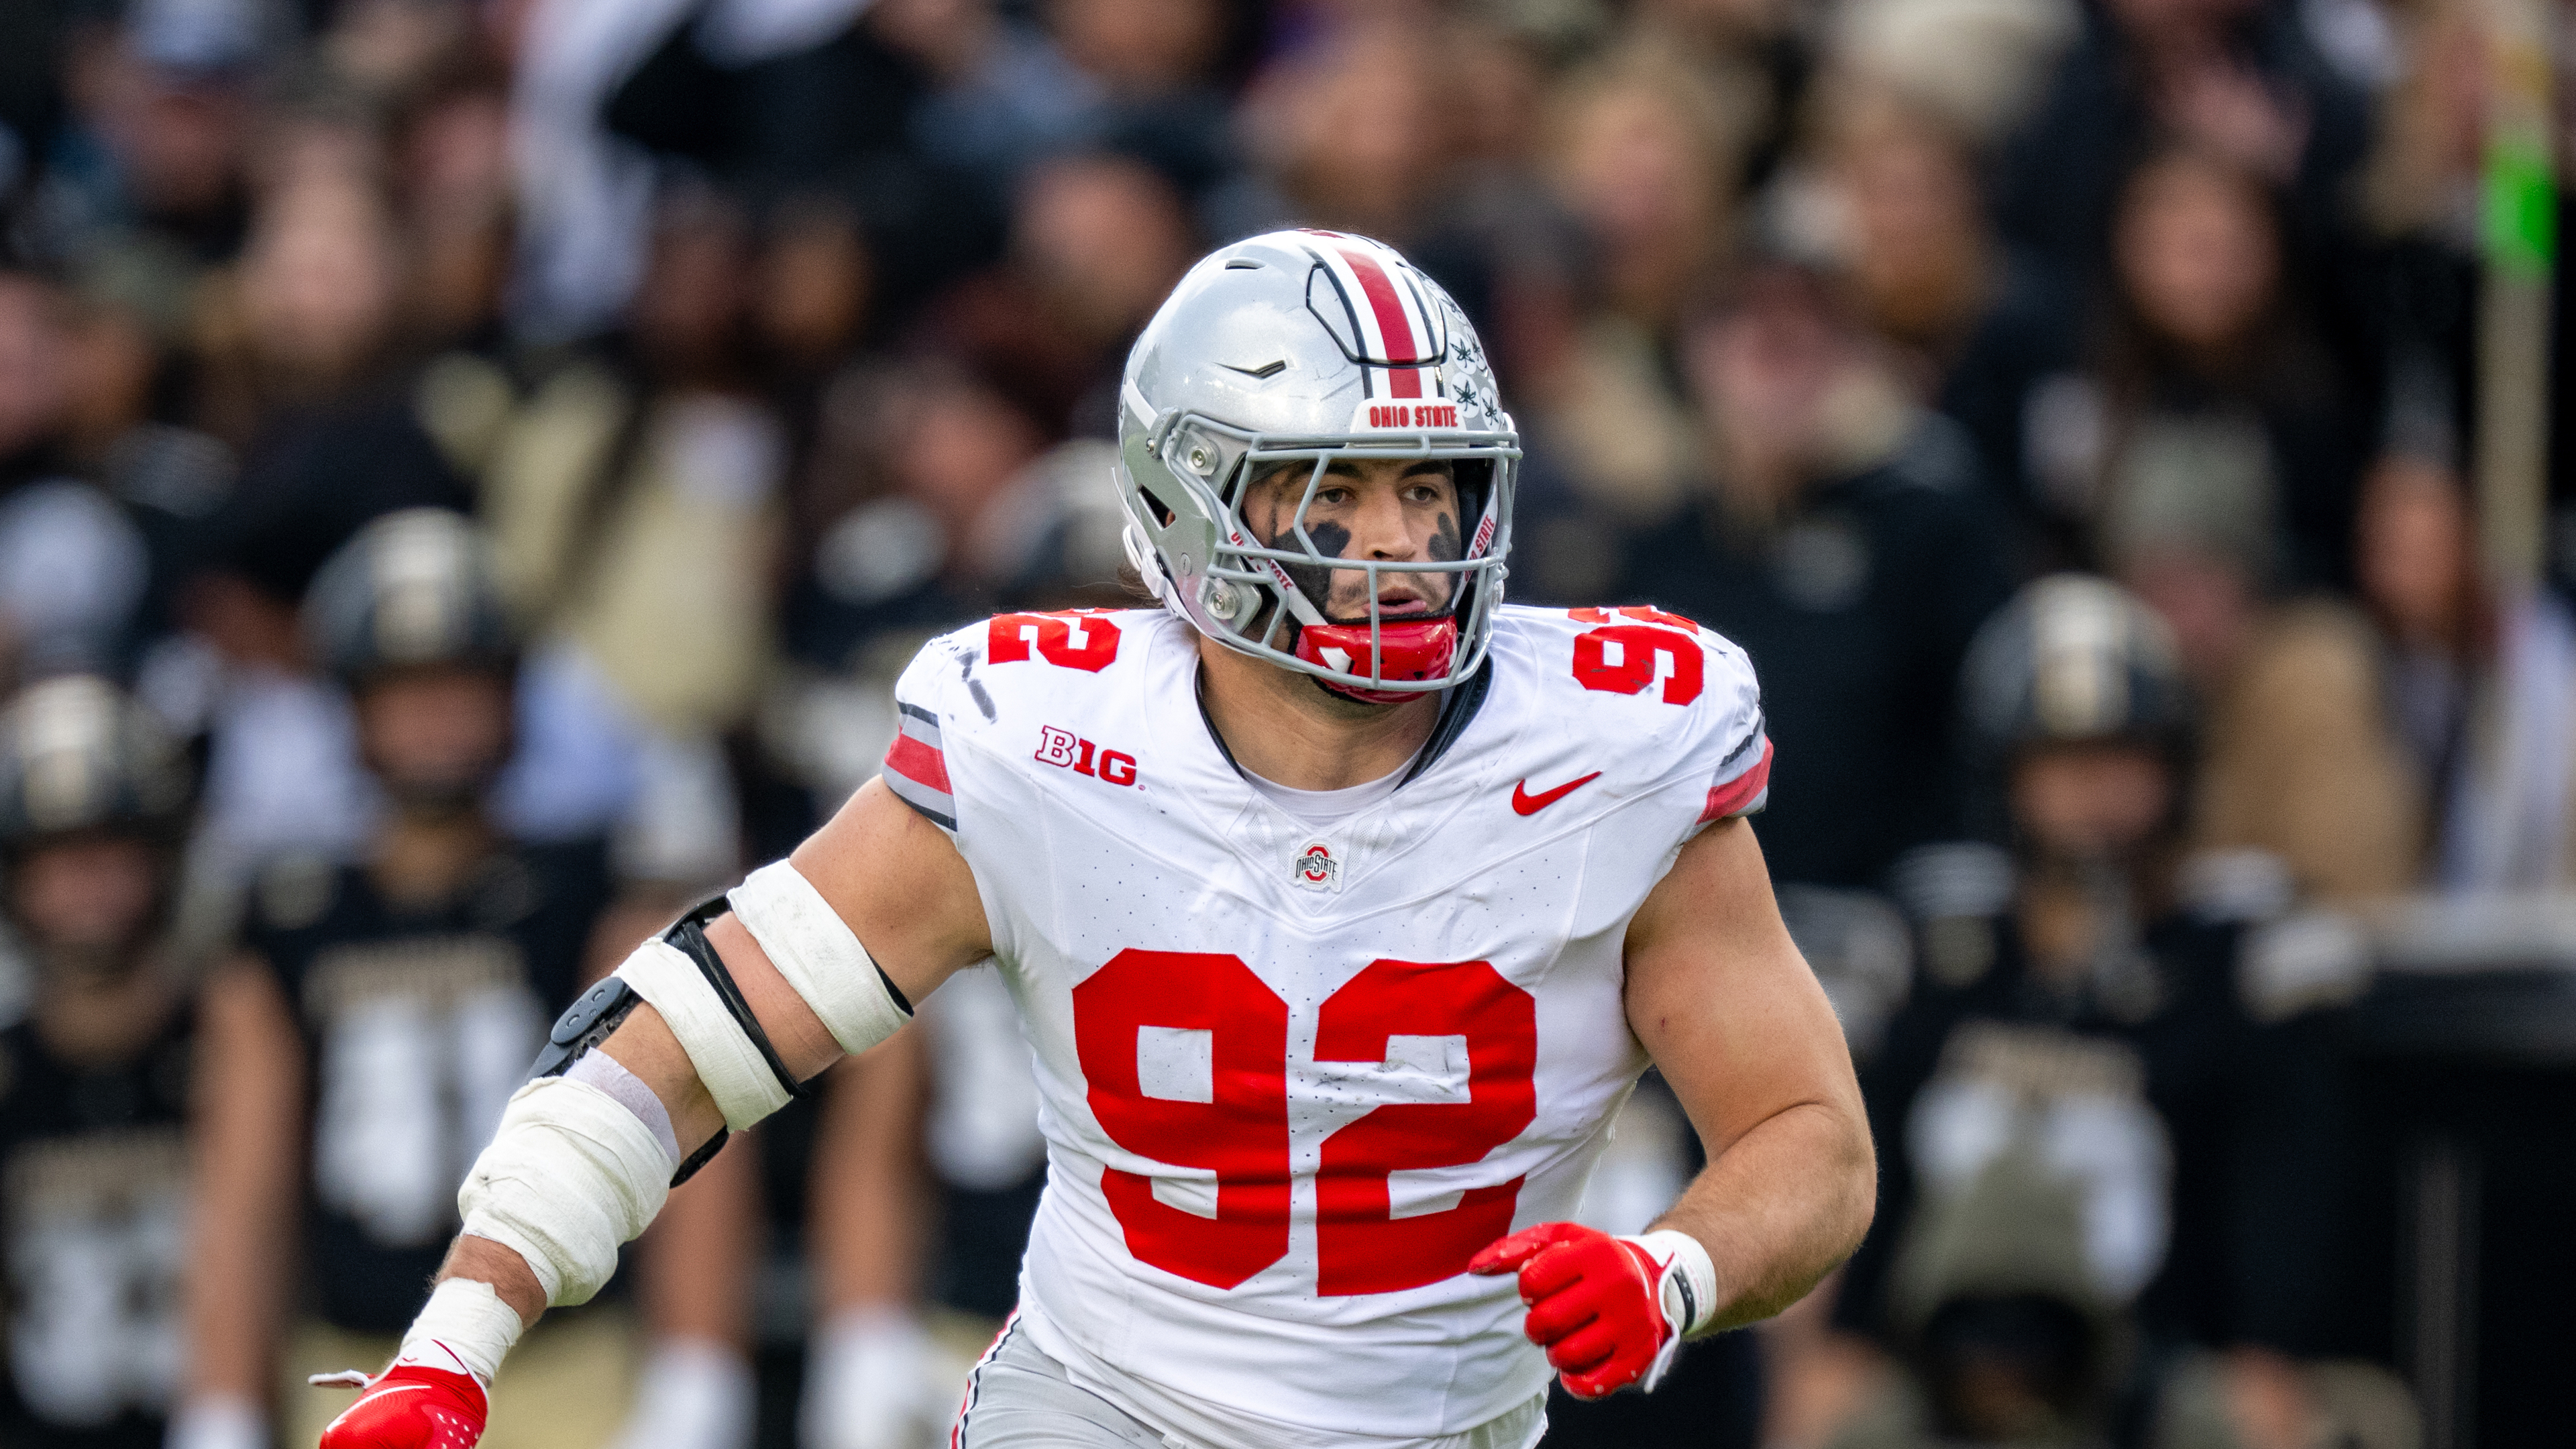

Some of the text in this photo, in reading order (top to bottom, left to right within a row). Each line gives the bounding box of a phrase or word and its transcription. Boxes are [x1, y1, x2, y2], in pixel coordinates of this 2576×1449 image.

[1370, 406, 1458, 427] OHIO STATE
[1475, 514, 1495, 552] STATE
[1072, 947, 1537, 1297] 92
